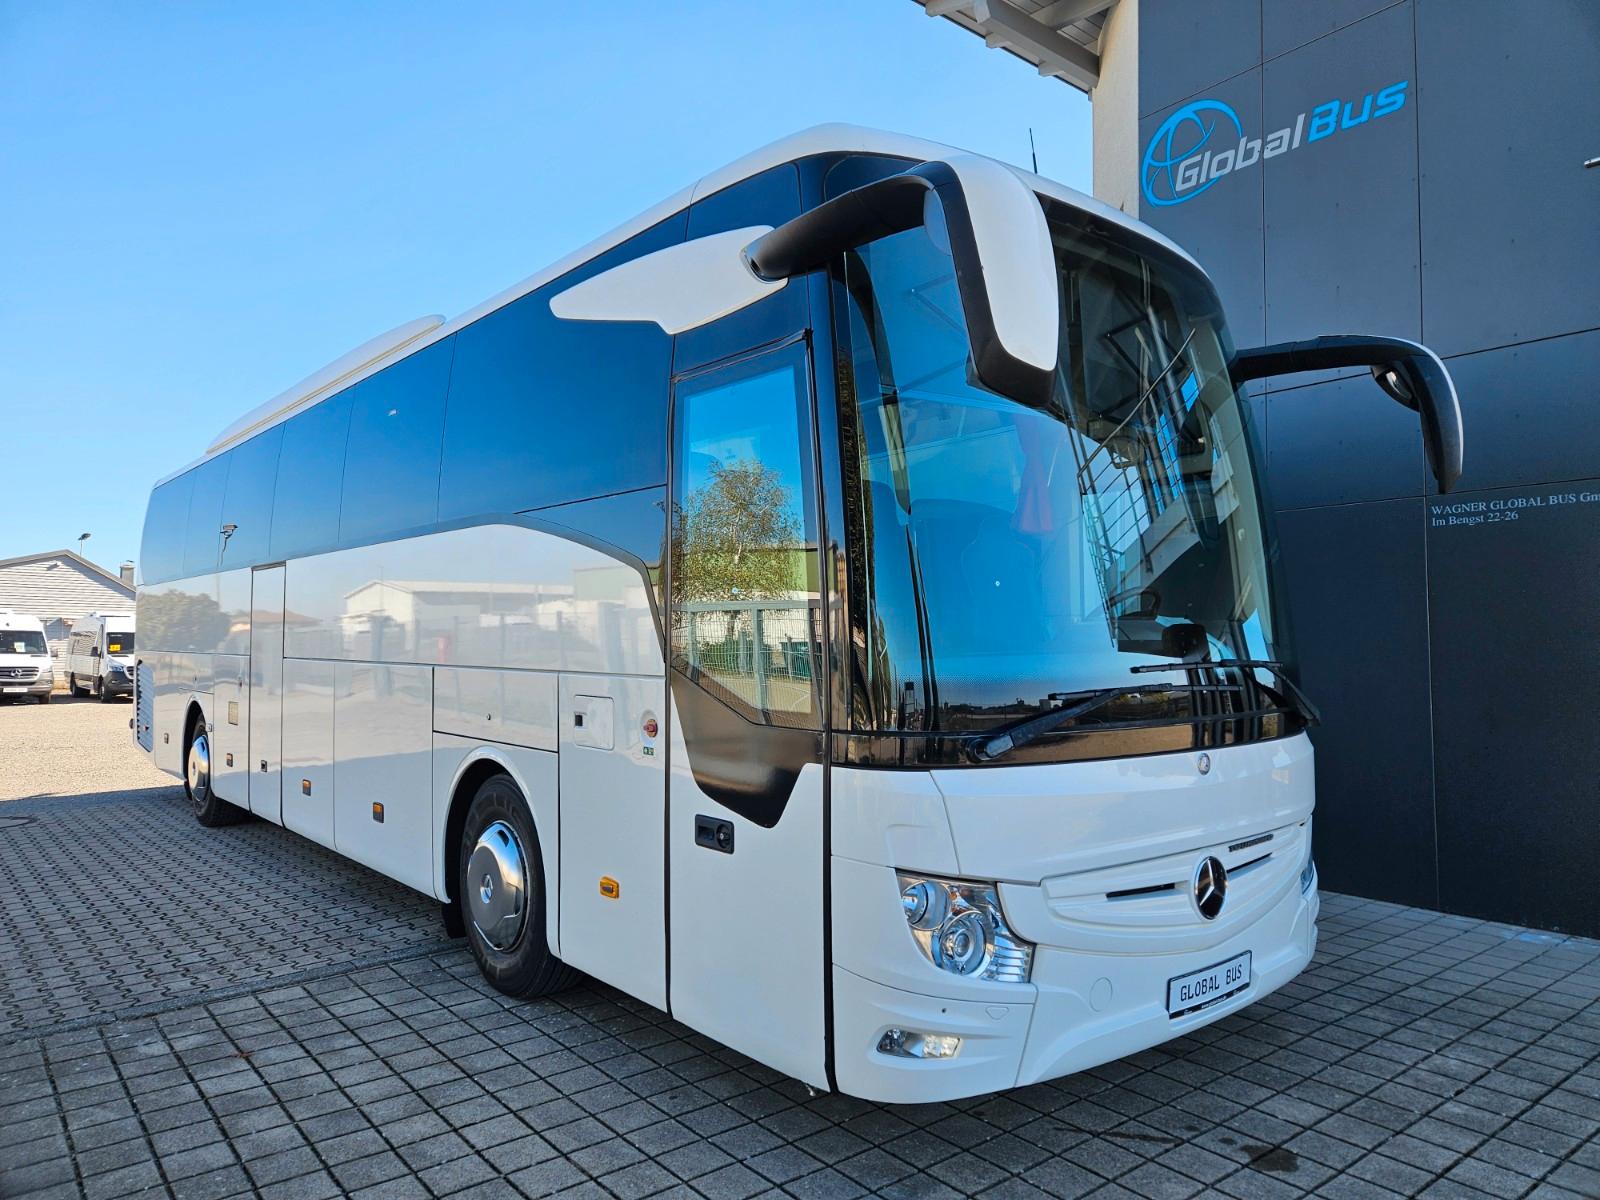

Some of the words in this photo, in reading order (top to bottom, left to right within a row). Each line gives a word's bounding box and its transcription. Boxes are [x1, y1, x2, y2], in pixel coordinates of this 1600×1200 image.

[1431, 502, 1487, 515] WAGNER
[1490, 496, 1546, 510] GLOBAL
[1549, 493, 1577, 504] BUS
[1432, 517, 1446, 527] Im
[1449, 514, 1484, 526] Bengst
[1487, 510, 1519, 522] 22-26
[1180, 975, 1220, 1002] GLOBAL
[1225, 964, 1242, 985] BUS
